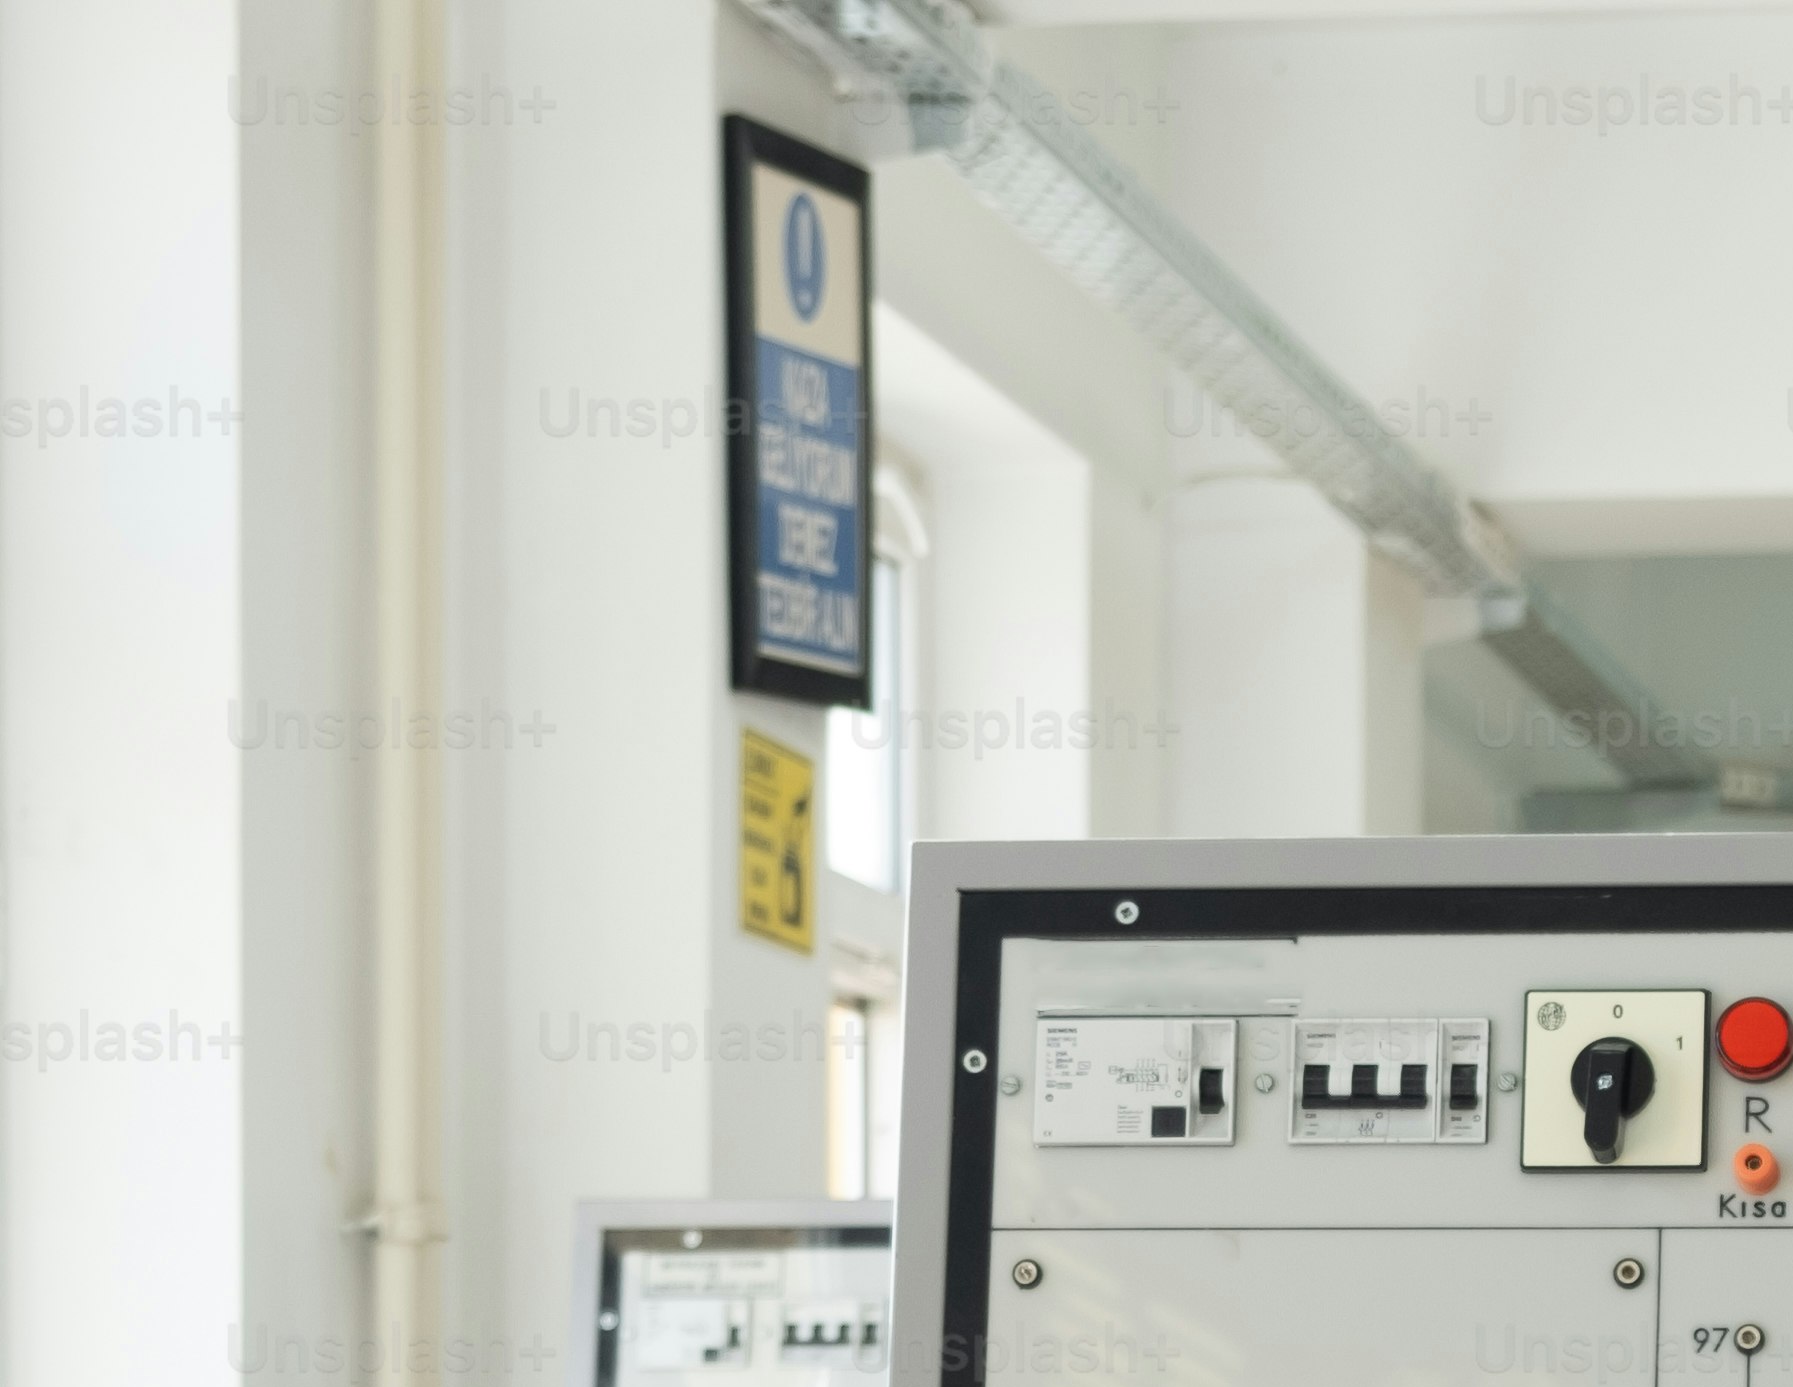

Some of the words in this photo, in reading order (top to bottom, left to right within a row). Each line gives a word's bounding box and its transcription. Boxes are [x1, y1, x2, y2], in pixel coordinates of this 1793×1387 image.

[1613, 1005, 1623, 1019] 0
[1677, 1036, 1682, 1050] 1
[1745, 1096, 1772, 1133] R
[1719, 1194, 1786, 1218] Kısa
[1693, 1328, 1729, 1353] 97
